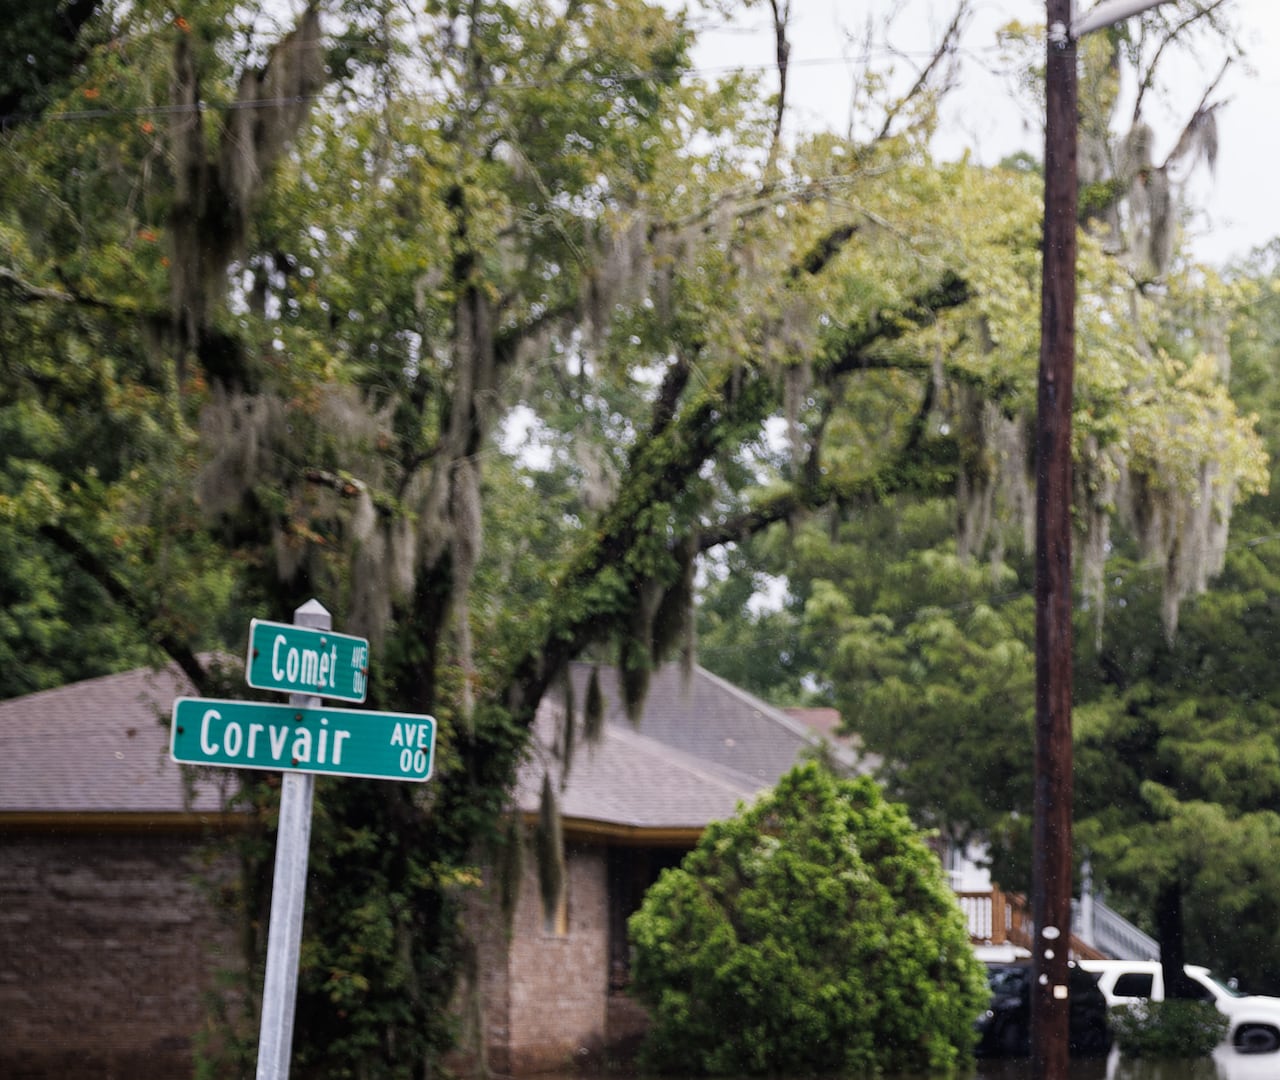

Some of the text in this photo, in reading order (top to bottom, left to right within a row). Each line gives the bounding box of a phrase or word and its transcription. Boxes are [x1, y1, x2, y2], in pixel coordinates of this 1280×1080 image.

[272, 634, 337, 688] Comet
[200, 709, 429, 765] Corvair AVE
[400, 748, 427, 774] 00
